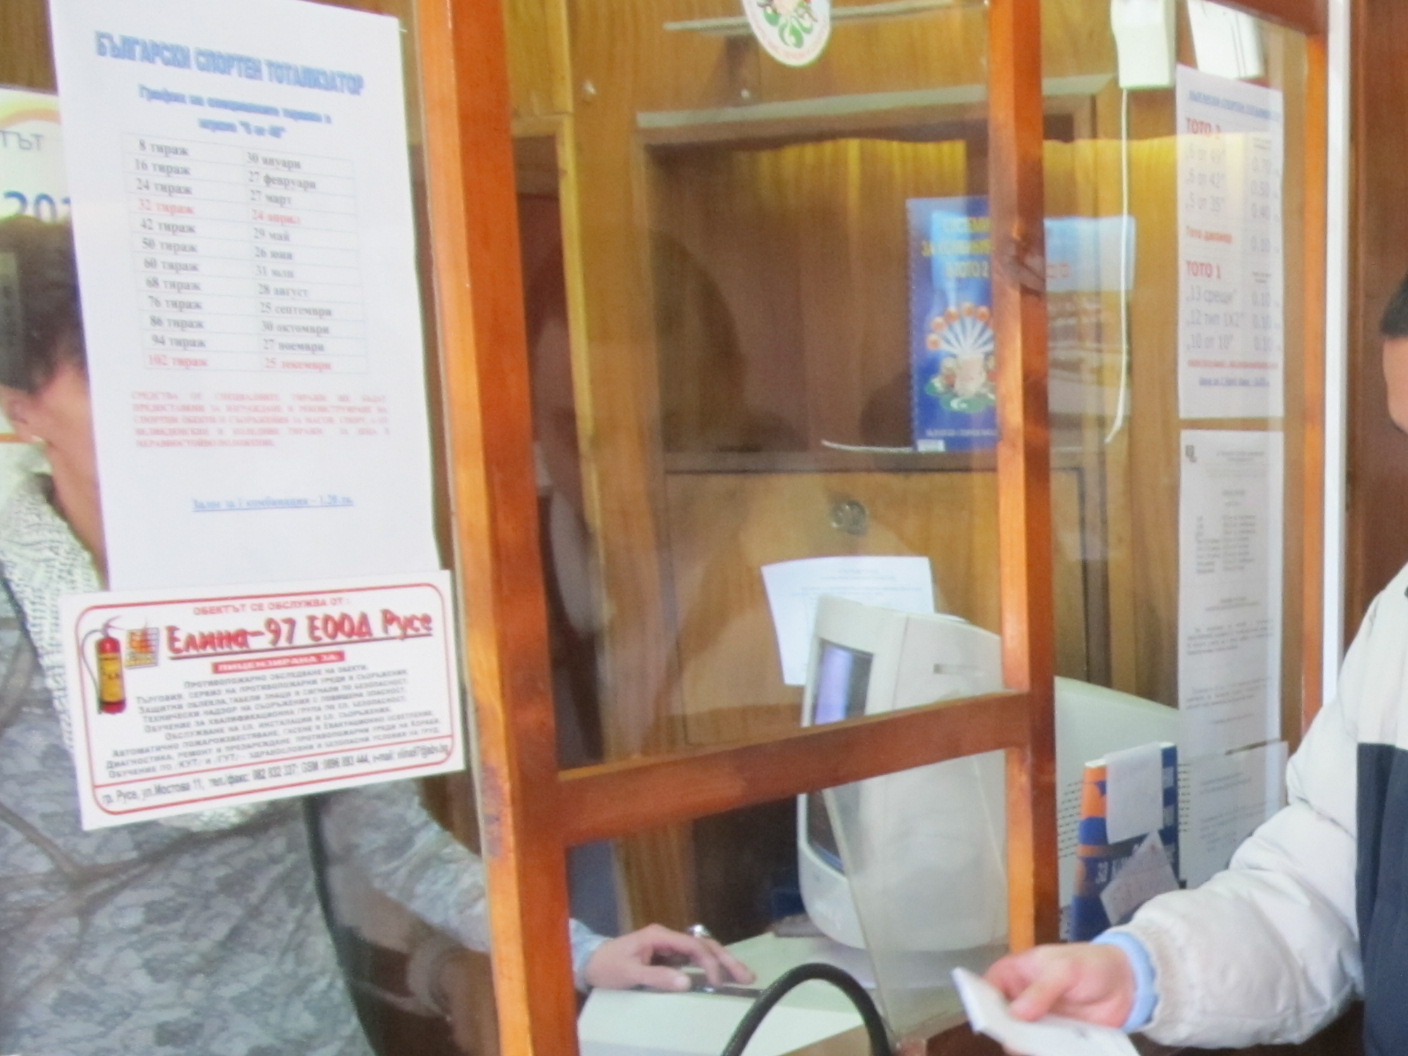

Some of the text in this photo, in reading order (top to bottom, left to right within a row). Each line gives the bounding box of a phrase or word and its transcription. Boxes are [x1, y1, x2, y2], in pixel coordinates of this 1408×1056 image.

[150, 144, 189, 156] тираж
[152, 164, 191, 176] тираж
[153, 183, 192, 195] тираж
[157, 222, 196, 233] тираж
[269, 230, 290, 242] май
[159, 241, 198, 253] тираж
[161, 262, 199, 273] тираж
[1186, 261, 1213, 278] ТОТО
[162, 281, 201, 292] тираж
[273, 288, 308, 300] август
[164, 300, 202, 311] тираж
[275, 306, 332, 317] септември
[167, 319, 204, 330] тираж
[277, 323, 330, 336] октомври
[169, 337, 206, 348] тираж
[194, 603, 246, 615] ОБЕКТЪТ
[251, 602, 264, 610] СЕ
[268, 599, 327, 611] ОБСЛУЖВА
[165, 608, 432, 654] Елина-97 ЕООД Русе
